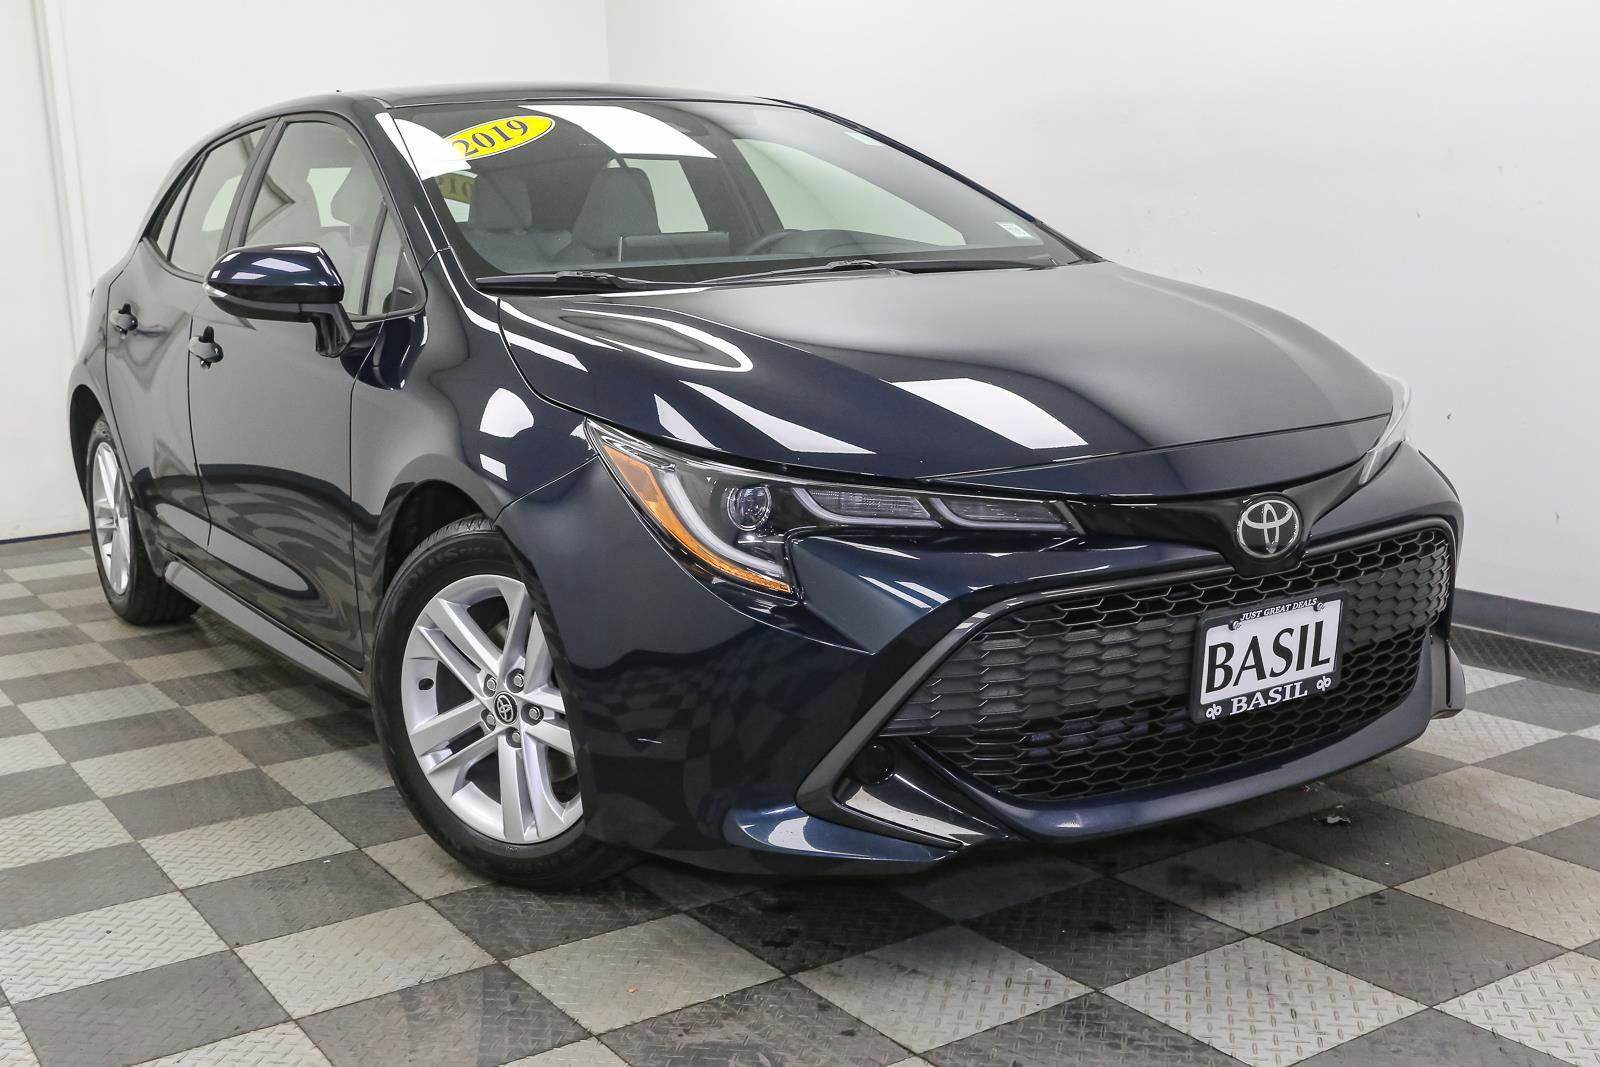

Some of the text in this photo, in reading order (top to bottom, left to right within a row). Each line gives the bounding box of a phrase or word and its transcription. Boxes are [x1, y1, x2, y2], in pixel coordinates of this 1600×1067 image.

[452, 120, 528, 157] 2019
[1241, 598, 1318, 620] JUST GREAT DEALS
[1205, 620, 1330, 693] BASIL
[1230, 682, 1308, 715] BASIL
